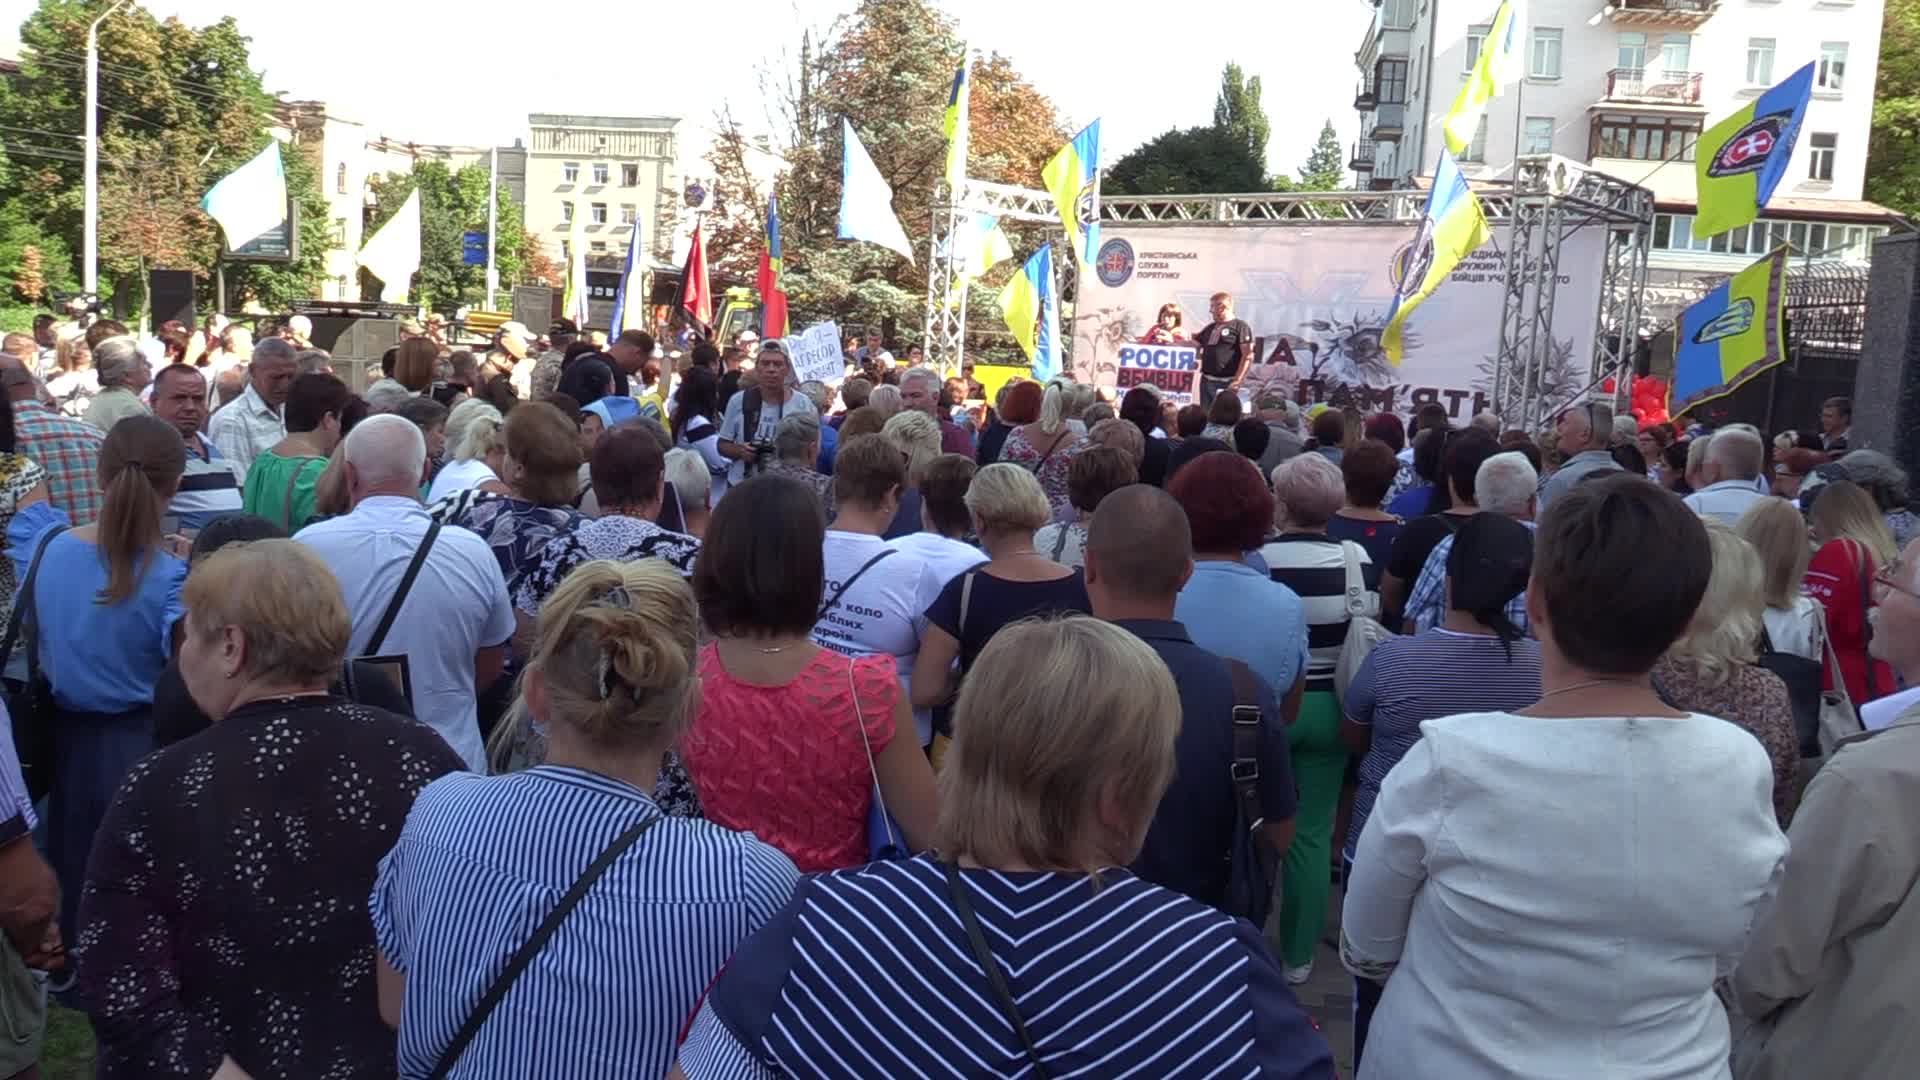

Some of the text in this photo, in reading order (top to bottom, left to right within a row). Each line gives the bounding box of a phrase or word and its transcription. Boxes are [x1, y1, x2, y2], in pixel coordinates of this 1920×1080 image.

[1120, 347, 1195, 370] РОСІЯ
[1117, 369, 1193, 392] ВБИВЦЯ
[846, 604, 883, 618] коло
